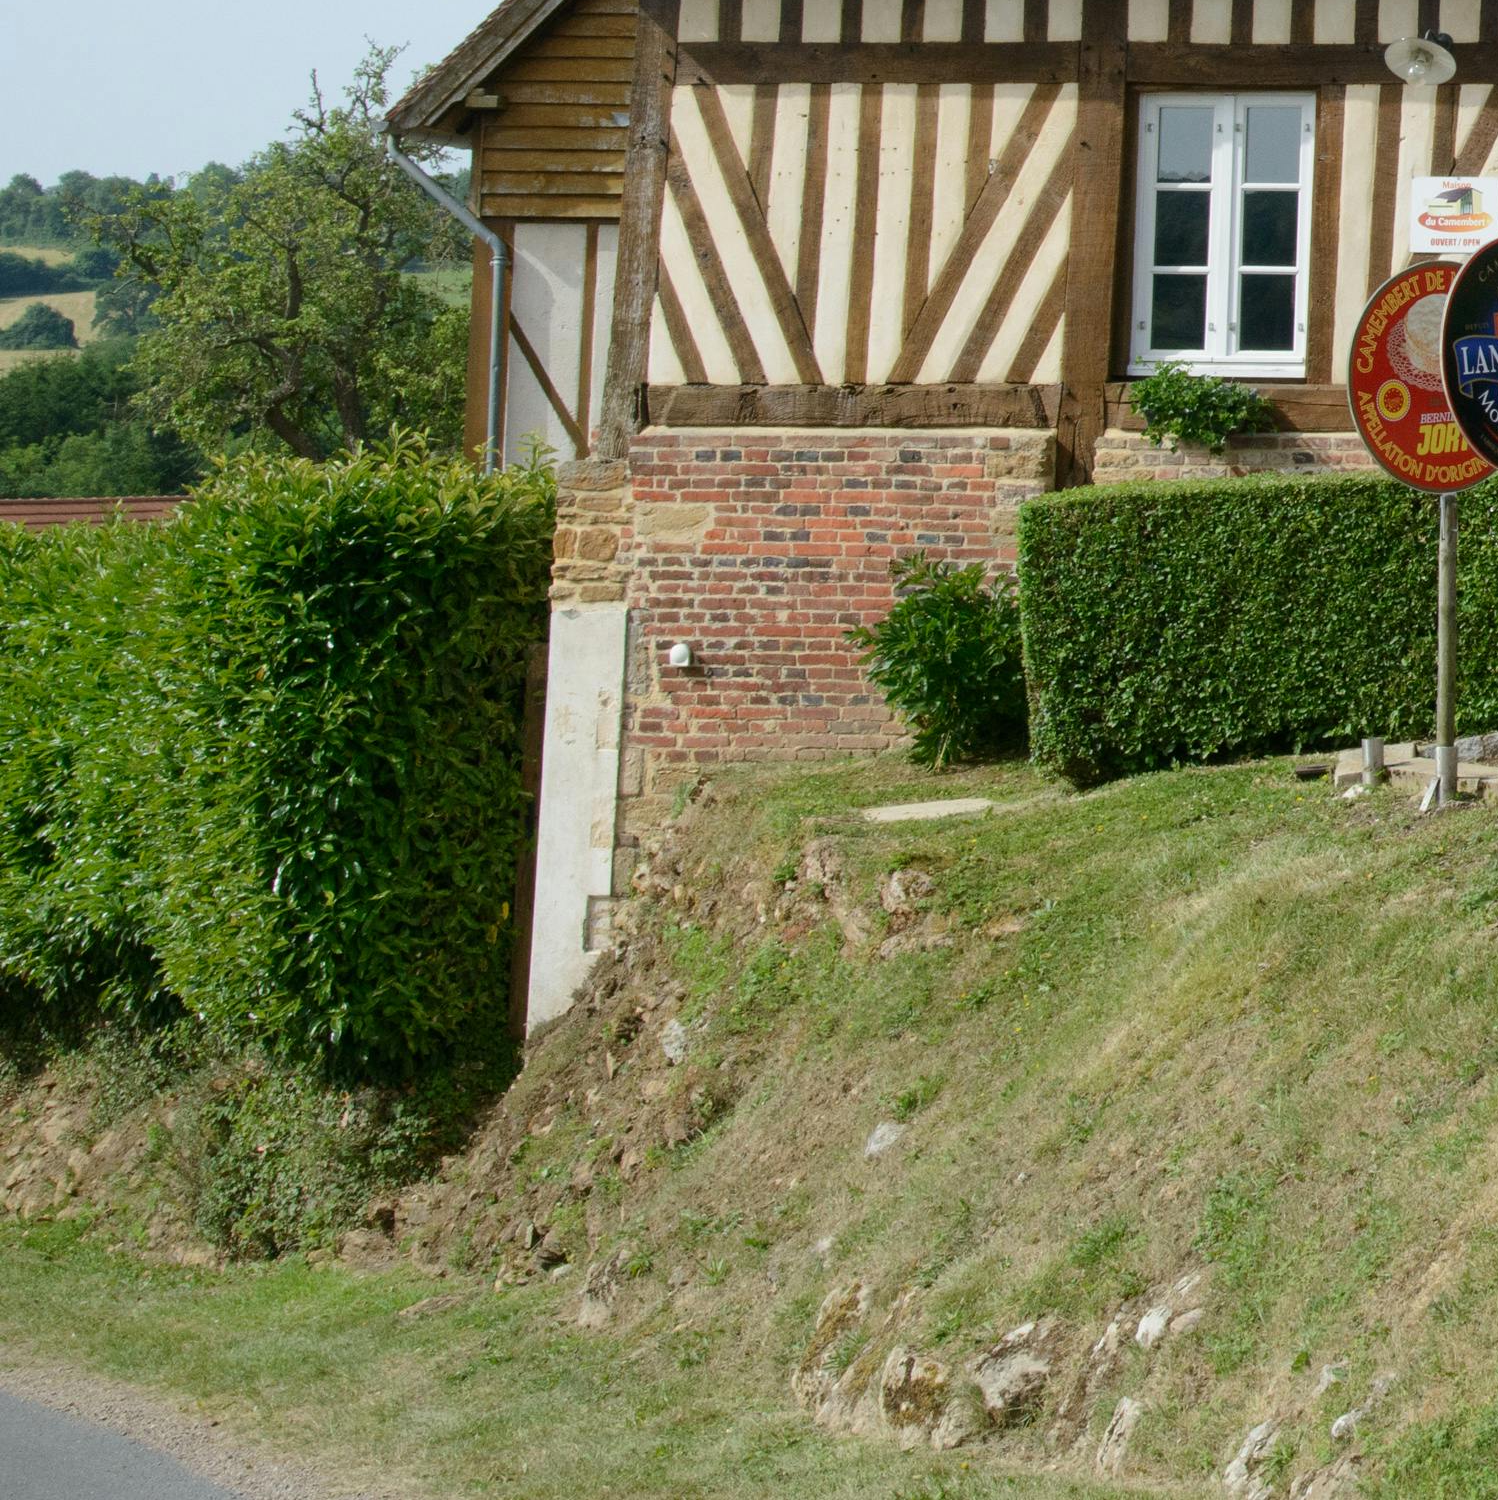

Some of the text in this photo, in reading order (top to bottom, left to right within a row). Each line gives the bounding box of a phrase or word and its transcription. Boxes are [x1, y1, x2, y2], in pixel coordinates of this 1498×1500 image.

[1442, 181, 1472, 189] Maison
[1425, 216, 1486, 227] du Camembert
[1430, 238, 1457, 247] OUVERT
[1463, 238, 1481, 247] OPEN
[1356, 270, 1446, 374] CAMEMBERT DE
[1357, 390, 1424, 479] APPELLATION
[1425, 457, 1489, 483] D'ORIGIN
